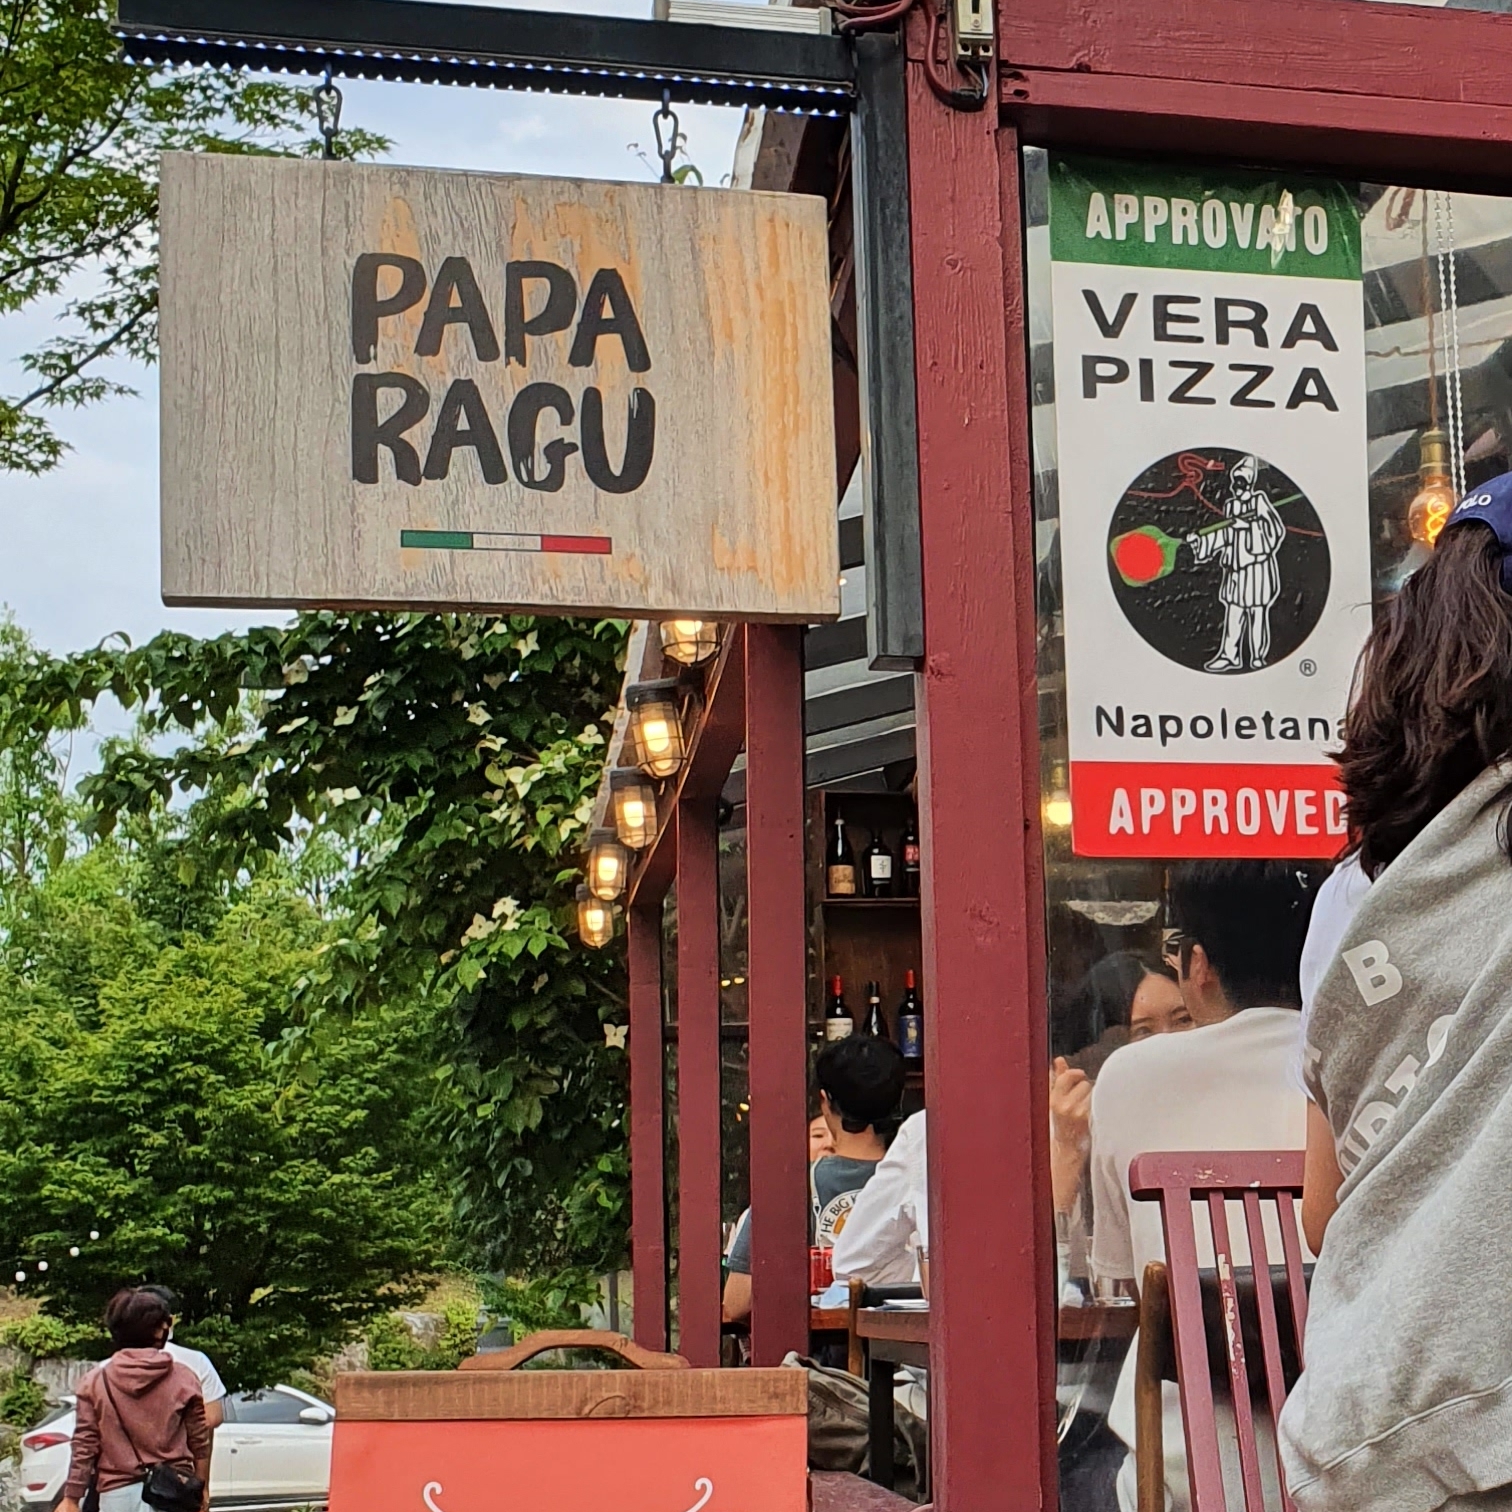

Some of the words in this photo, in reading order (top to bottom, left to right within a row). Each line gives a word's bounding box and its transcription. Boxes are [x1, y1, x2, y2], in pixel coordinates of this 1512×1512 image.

[352, 252, 652, 373] PAPA
[1082, 289, 1339, 353] VERA
[1081, 354, 1339, 412] PIZZA
[350, 372, 657, 494] RAGU
[1108, 786, 1349, 836] APPROVED
[830, 1198, 850, 1216] BIG
